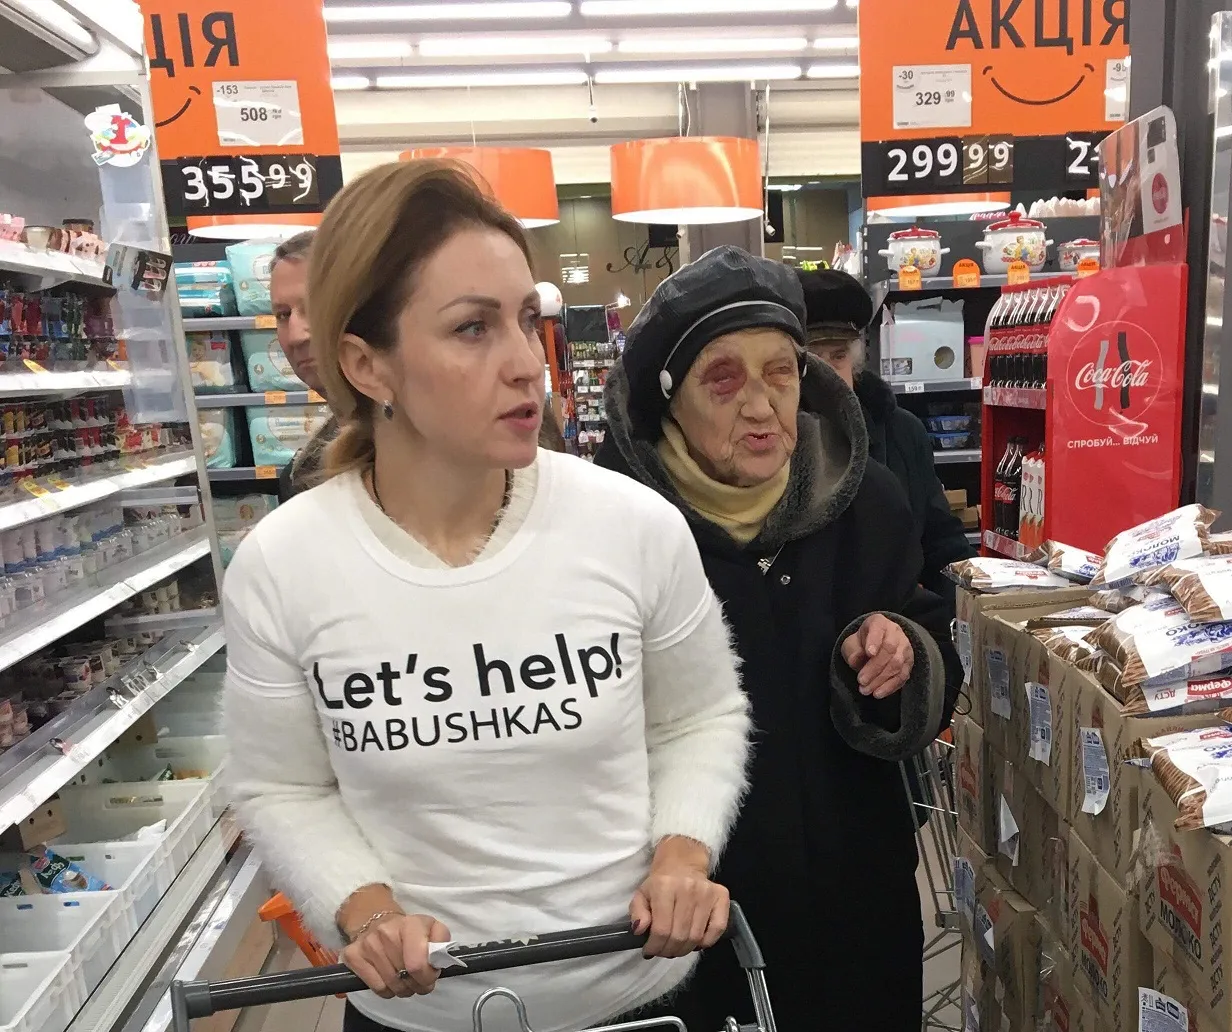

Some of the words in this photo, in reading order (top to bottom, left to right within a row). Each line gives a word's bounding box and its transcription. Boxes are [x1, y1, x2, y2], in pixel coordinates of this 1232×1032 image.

[945, 0, 1130, 56] АКЦІЯ
[898, 70, 914, 81] -30
[216, 85, 239, 95] -153
[915, 91, 942, 106] 329
[240, 107, 268, 121] 508
[887, 143, 958, 181] 299
[1075, 359, 1155, 391] Coca-Cola
[1067, 435, 1121, 449] СПРОБУЙ...
[1123, 433, 1159, 446] ВІДЧУЙ
[1165, 623, 1202, 636] ОКО
[313, 653, 453, 710] Let's
[472, 632, 623, 698] help!
[1190, 680, 1232, 692] Ферма
[1154, 688, 1176, 700] ДСТУ
[331, 697, 583, 753] #BABUSHKAS
